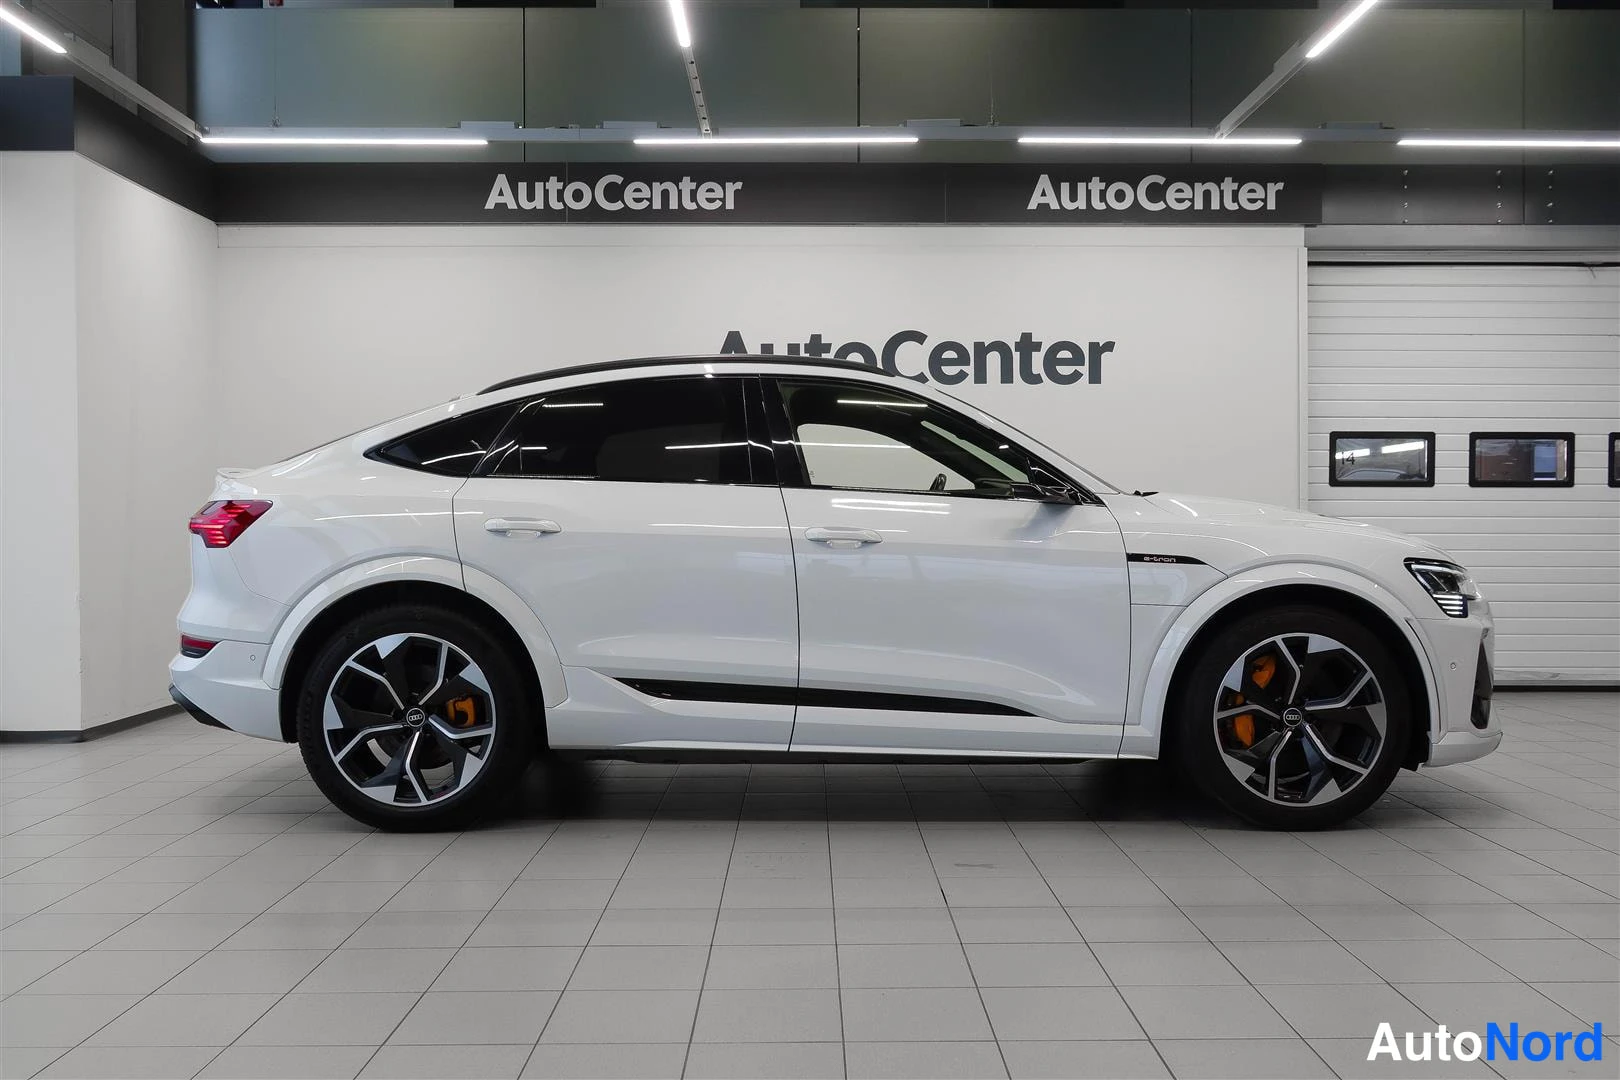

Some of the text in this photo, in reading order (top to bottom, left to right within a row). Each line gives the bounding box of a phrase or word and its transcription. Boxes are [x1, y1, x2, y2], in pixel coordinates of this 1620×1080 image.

[485, 174, 742, 211] AutoCenter
[1027, 174, 1284, 211] AutoCenter
[720, 330, 1115, 385] toCenter
